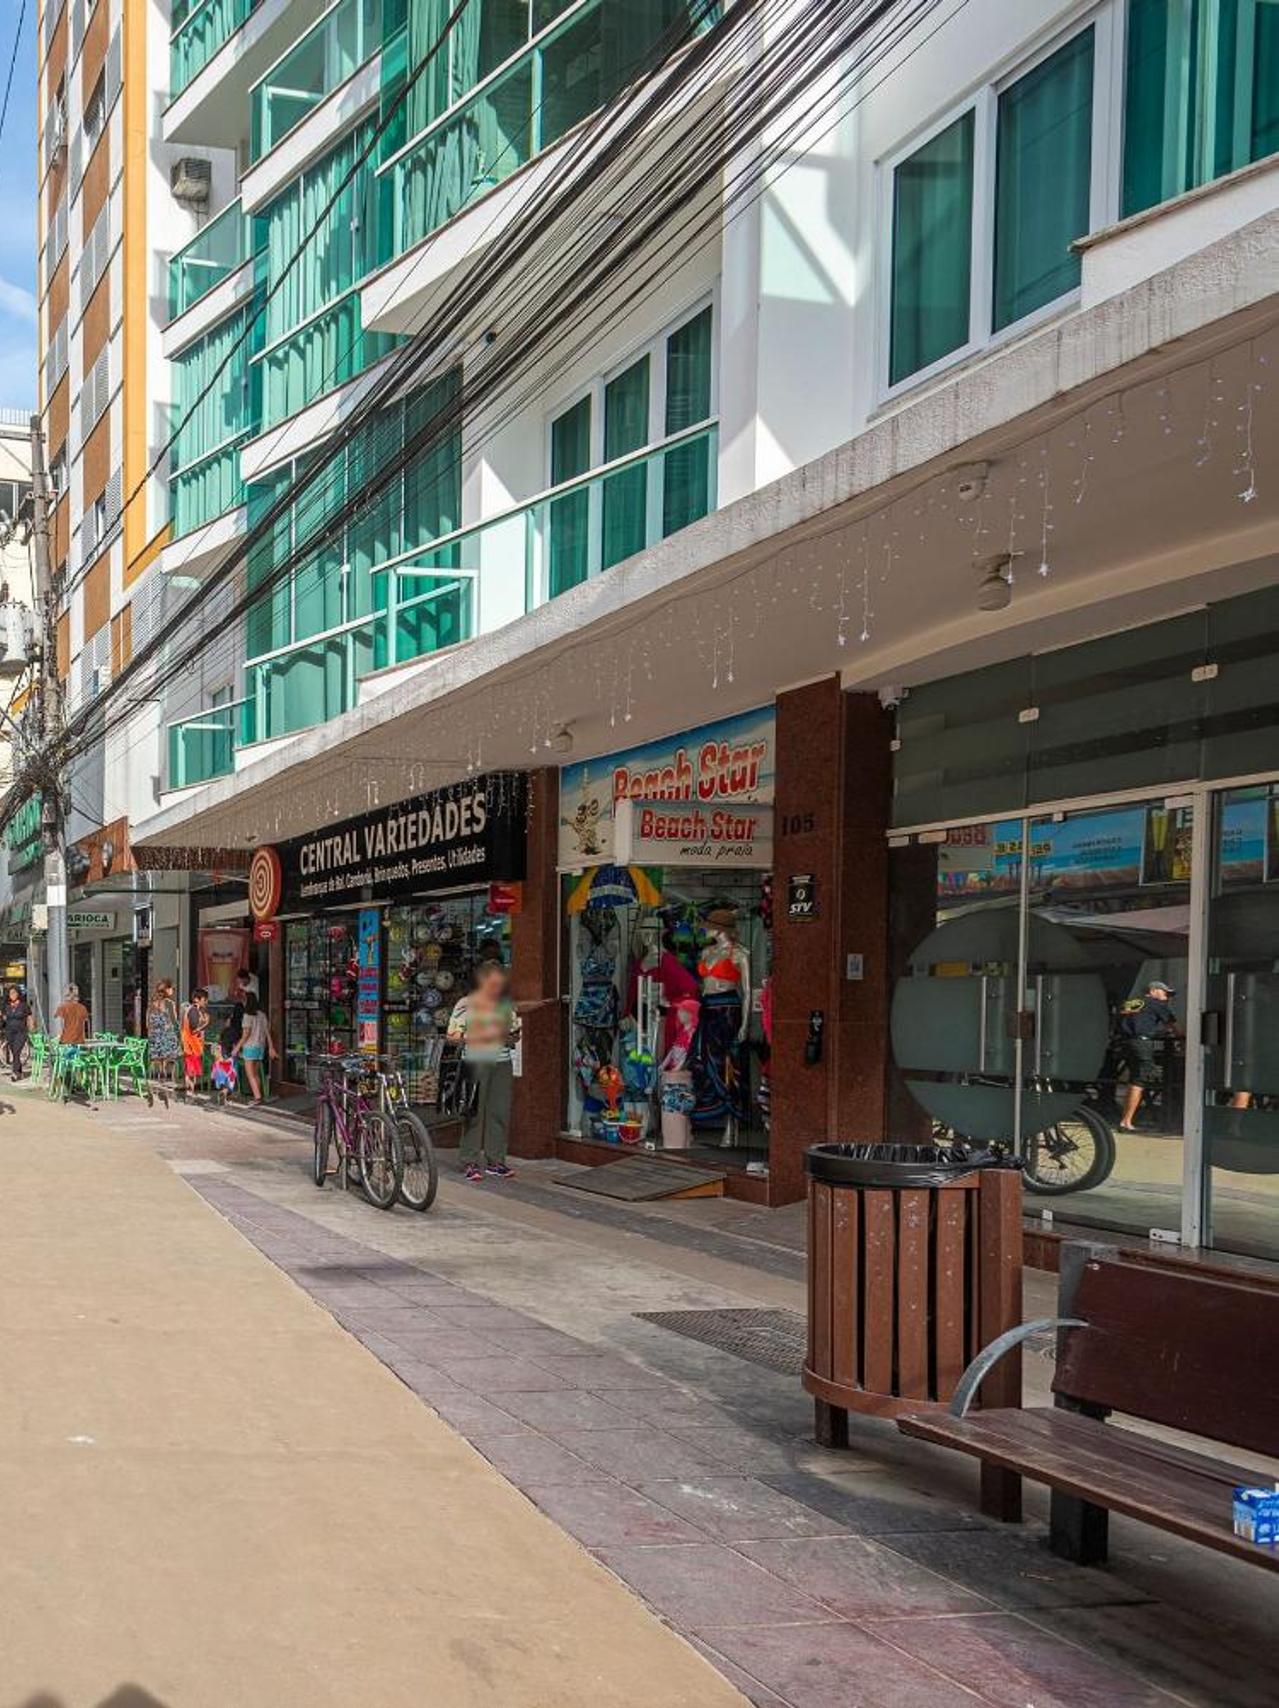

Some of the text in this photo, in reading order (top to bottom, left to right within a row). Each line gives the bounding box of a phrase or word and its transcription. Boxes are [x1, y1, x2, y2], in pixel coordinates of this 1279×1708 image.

[697, 741, 768, 800] Star
[300, 793, 487, 876] CENTRAL VARIEDADES
[640, 808, 757, 842] Beach Star
[782, 814, 815, 836] 105
[680, 842, 754, 860] moda praia
[67, 914, 108, 922] ARIOCA
[789, 902, 813, 914] STV
